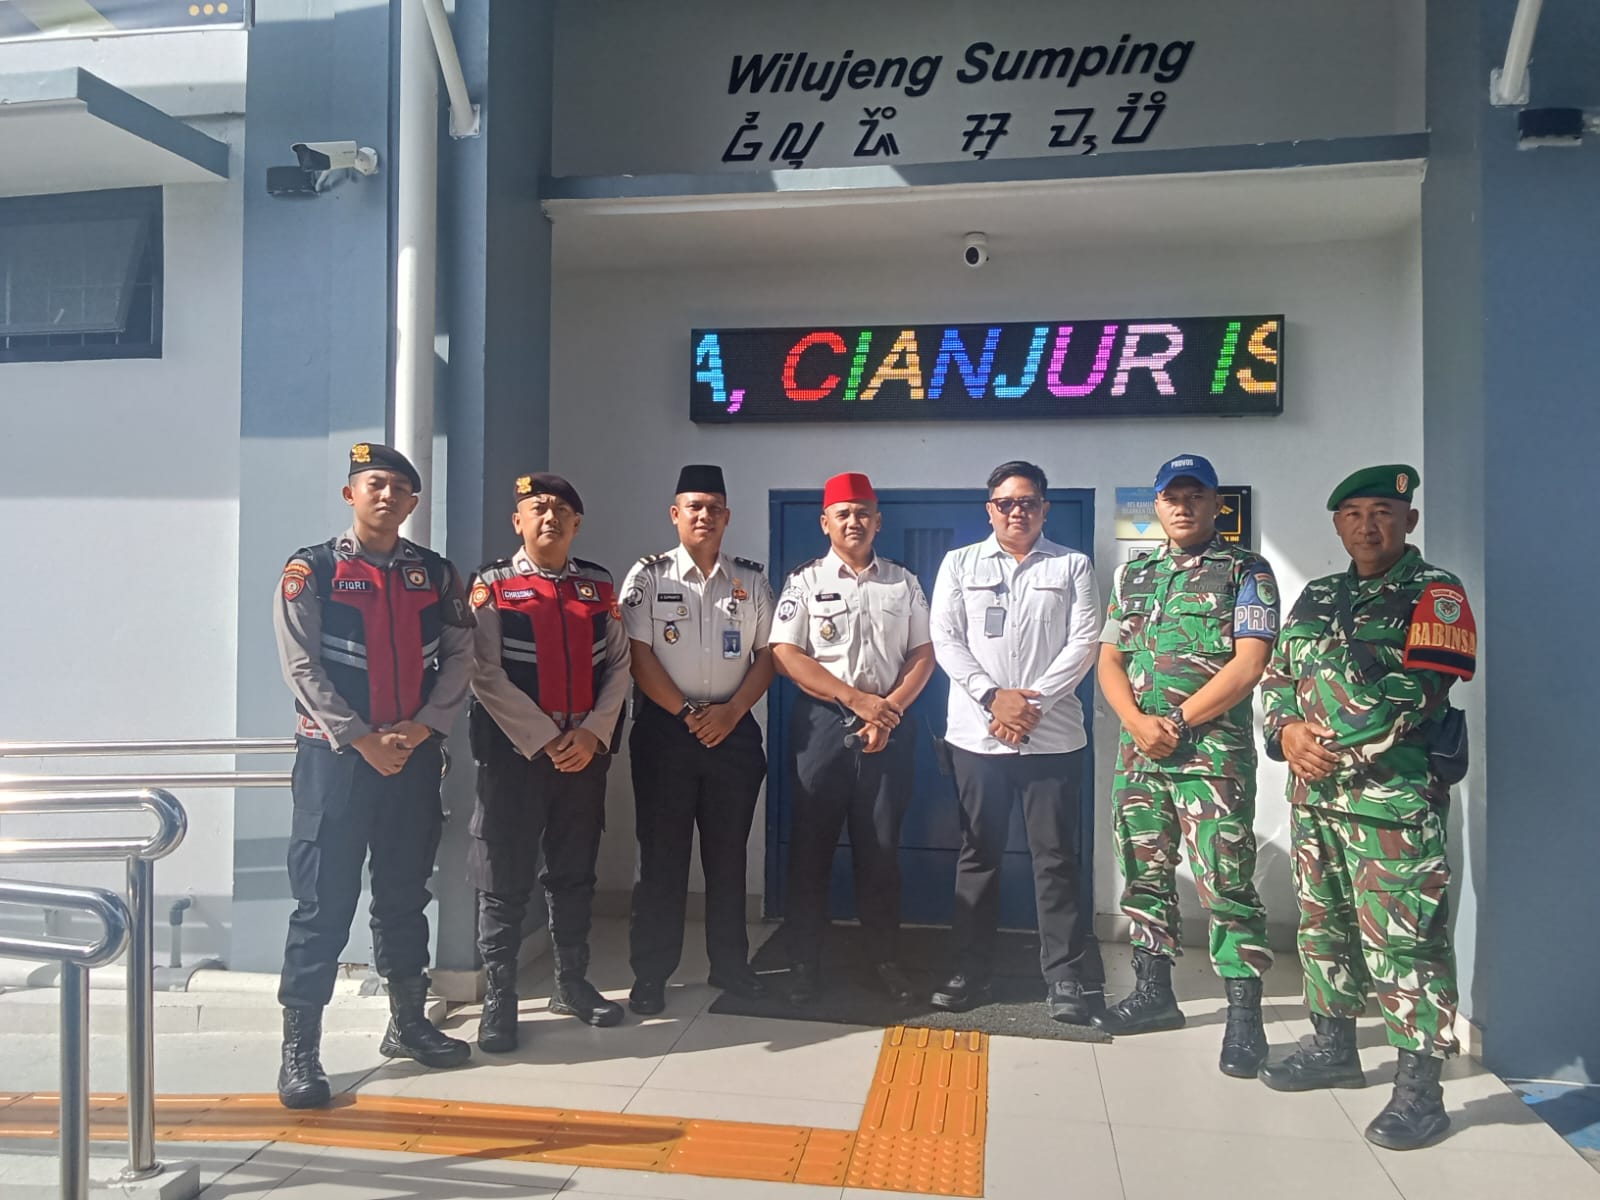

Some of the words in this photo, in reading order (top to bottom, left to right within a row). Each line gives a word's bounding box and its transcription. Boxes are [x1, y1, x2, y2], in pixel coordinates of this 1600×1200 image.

[728, 50, 943, 101] Wilujeng
[956, 33, 1195, 88] Sumping
[781, 324, 1184, 401] CIANJUR
[1171, 459, 1194, 469] PROVOS
[1409, 622, 1477, 656] BABINSA
